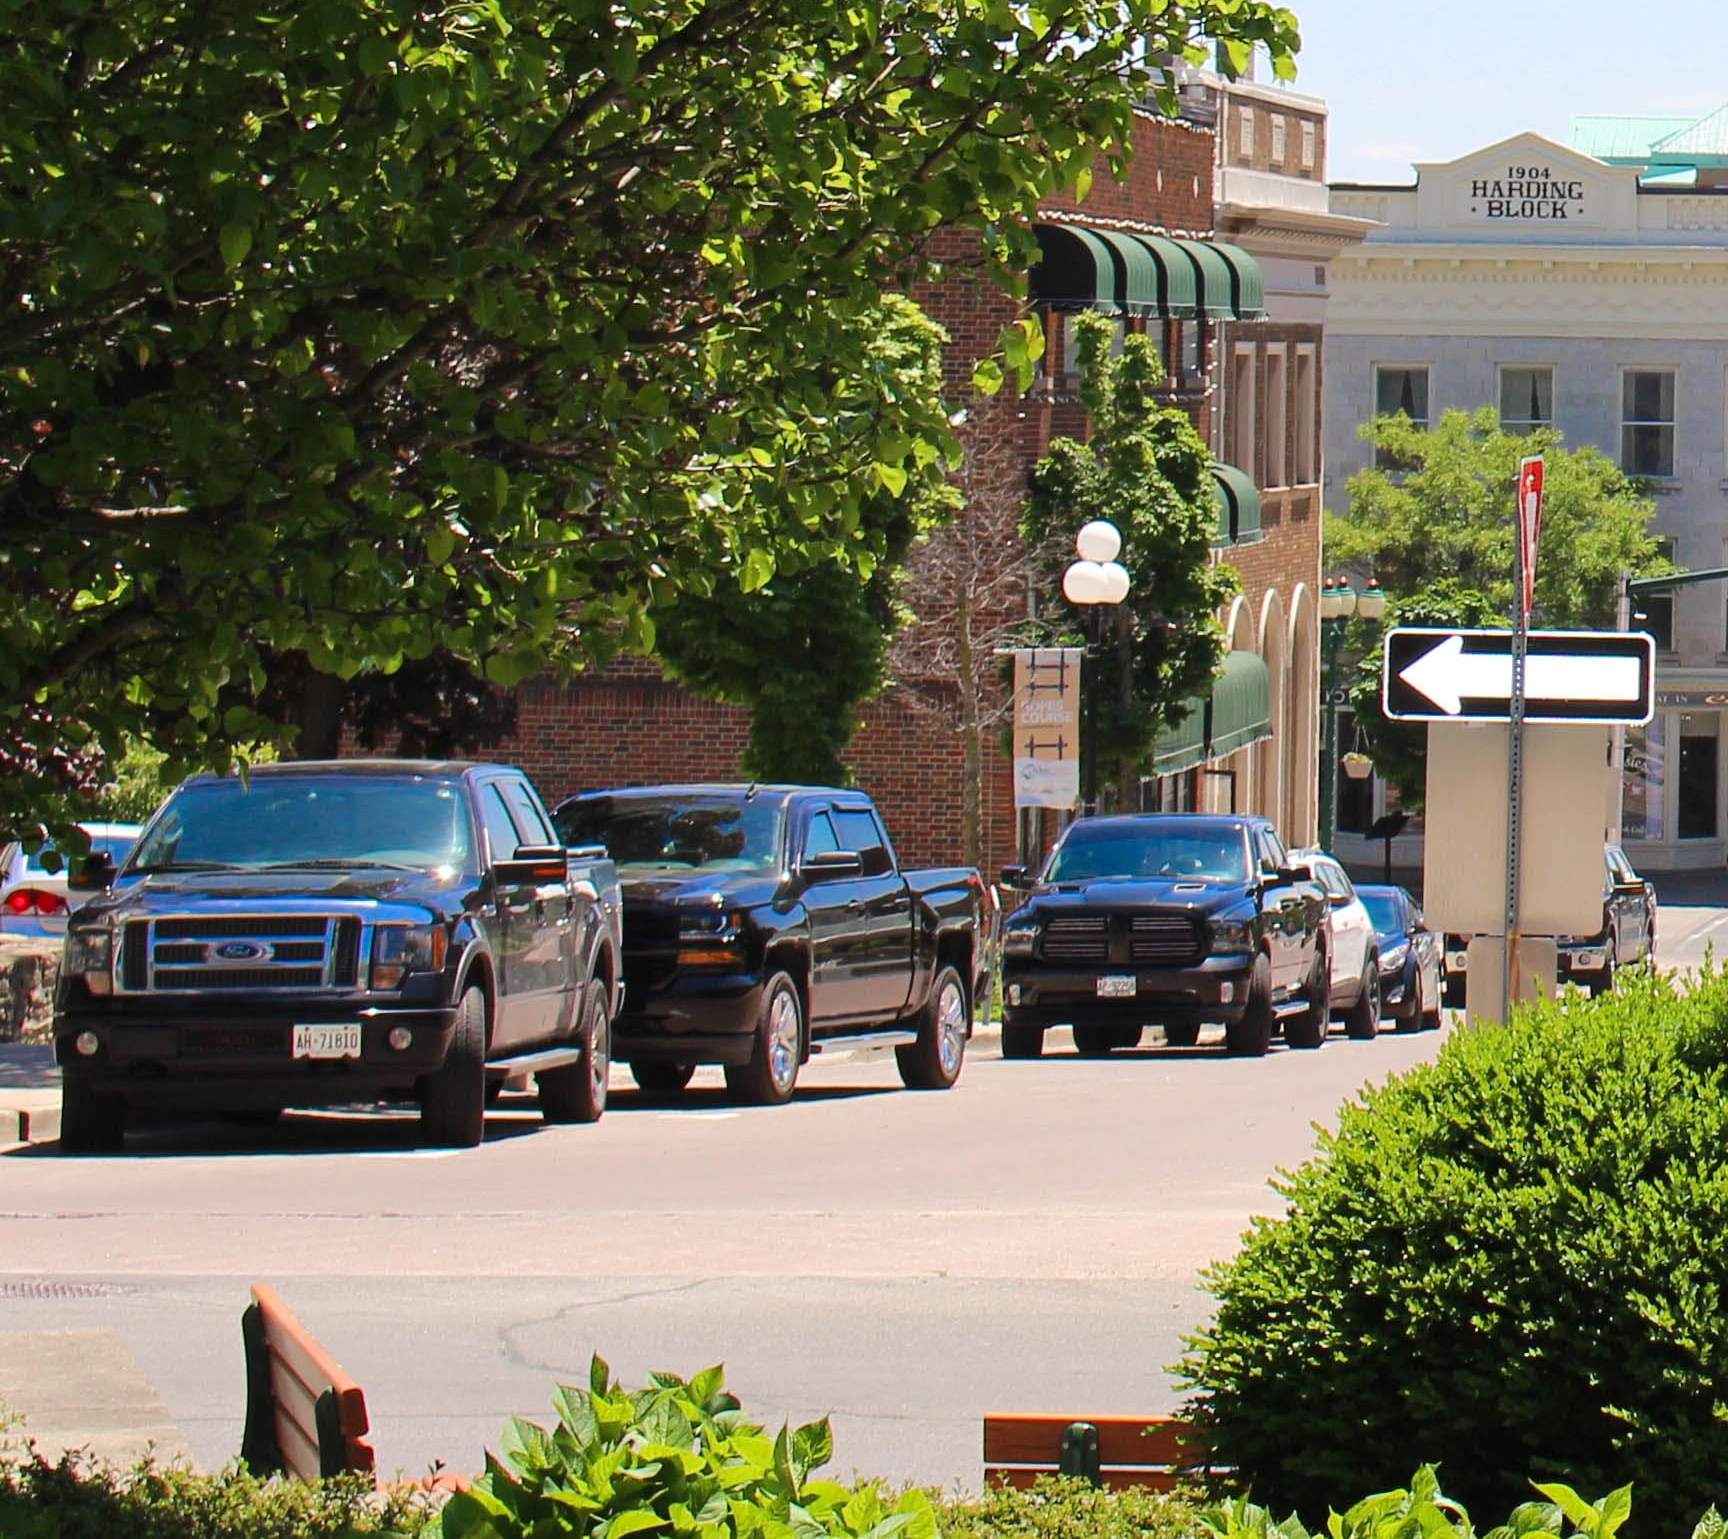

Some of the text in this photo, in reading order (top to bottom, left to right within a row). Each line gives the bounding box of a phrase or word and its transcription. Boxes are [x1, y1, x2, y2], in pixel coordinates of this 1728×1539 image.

[1508, 166, 1551, 180] 1904
[1471, 179, 1583, 200] HARDING
[1486, 200, 1568, 219] BLOCK
[1021, 711, 1074, 724] COURSE
